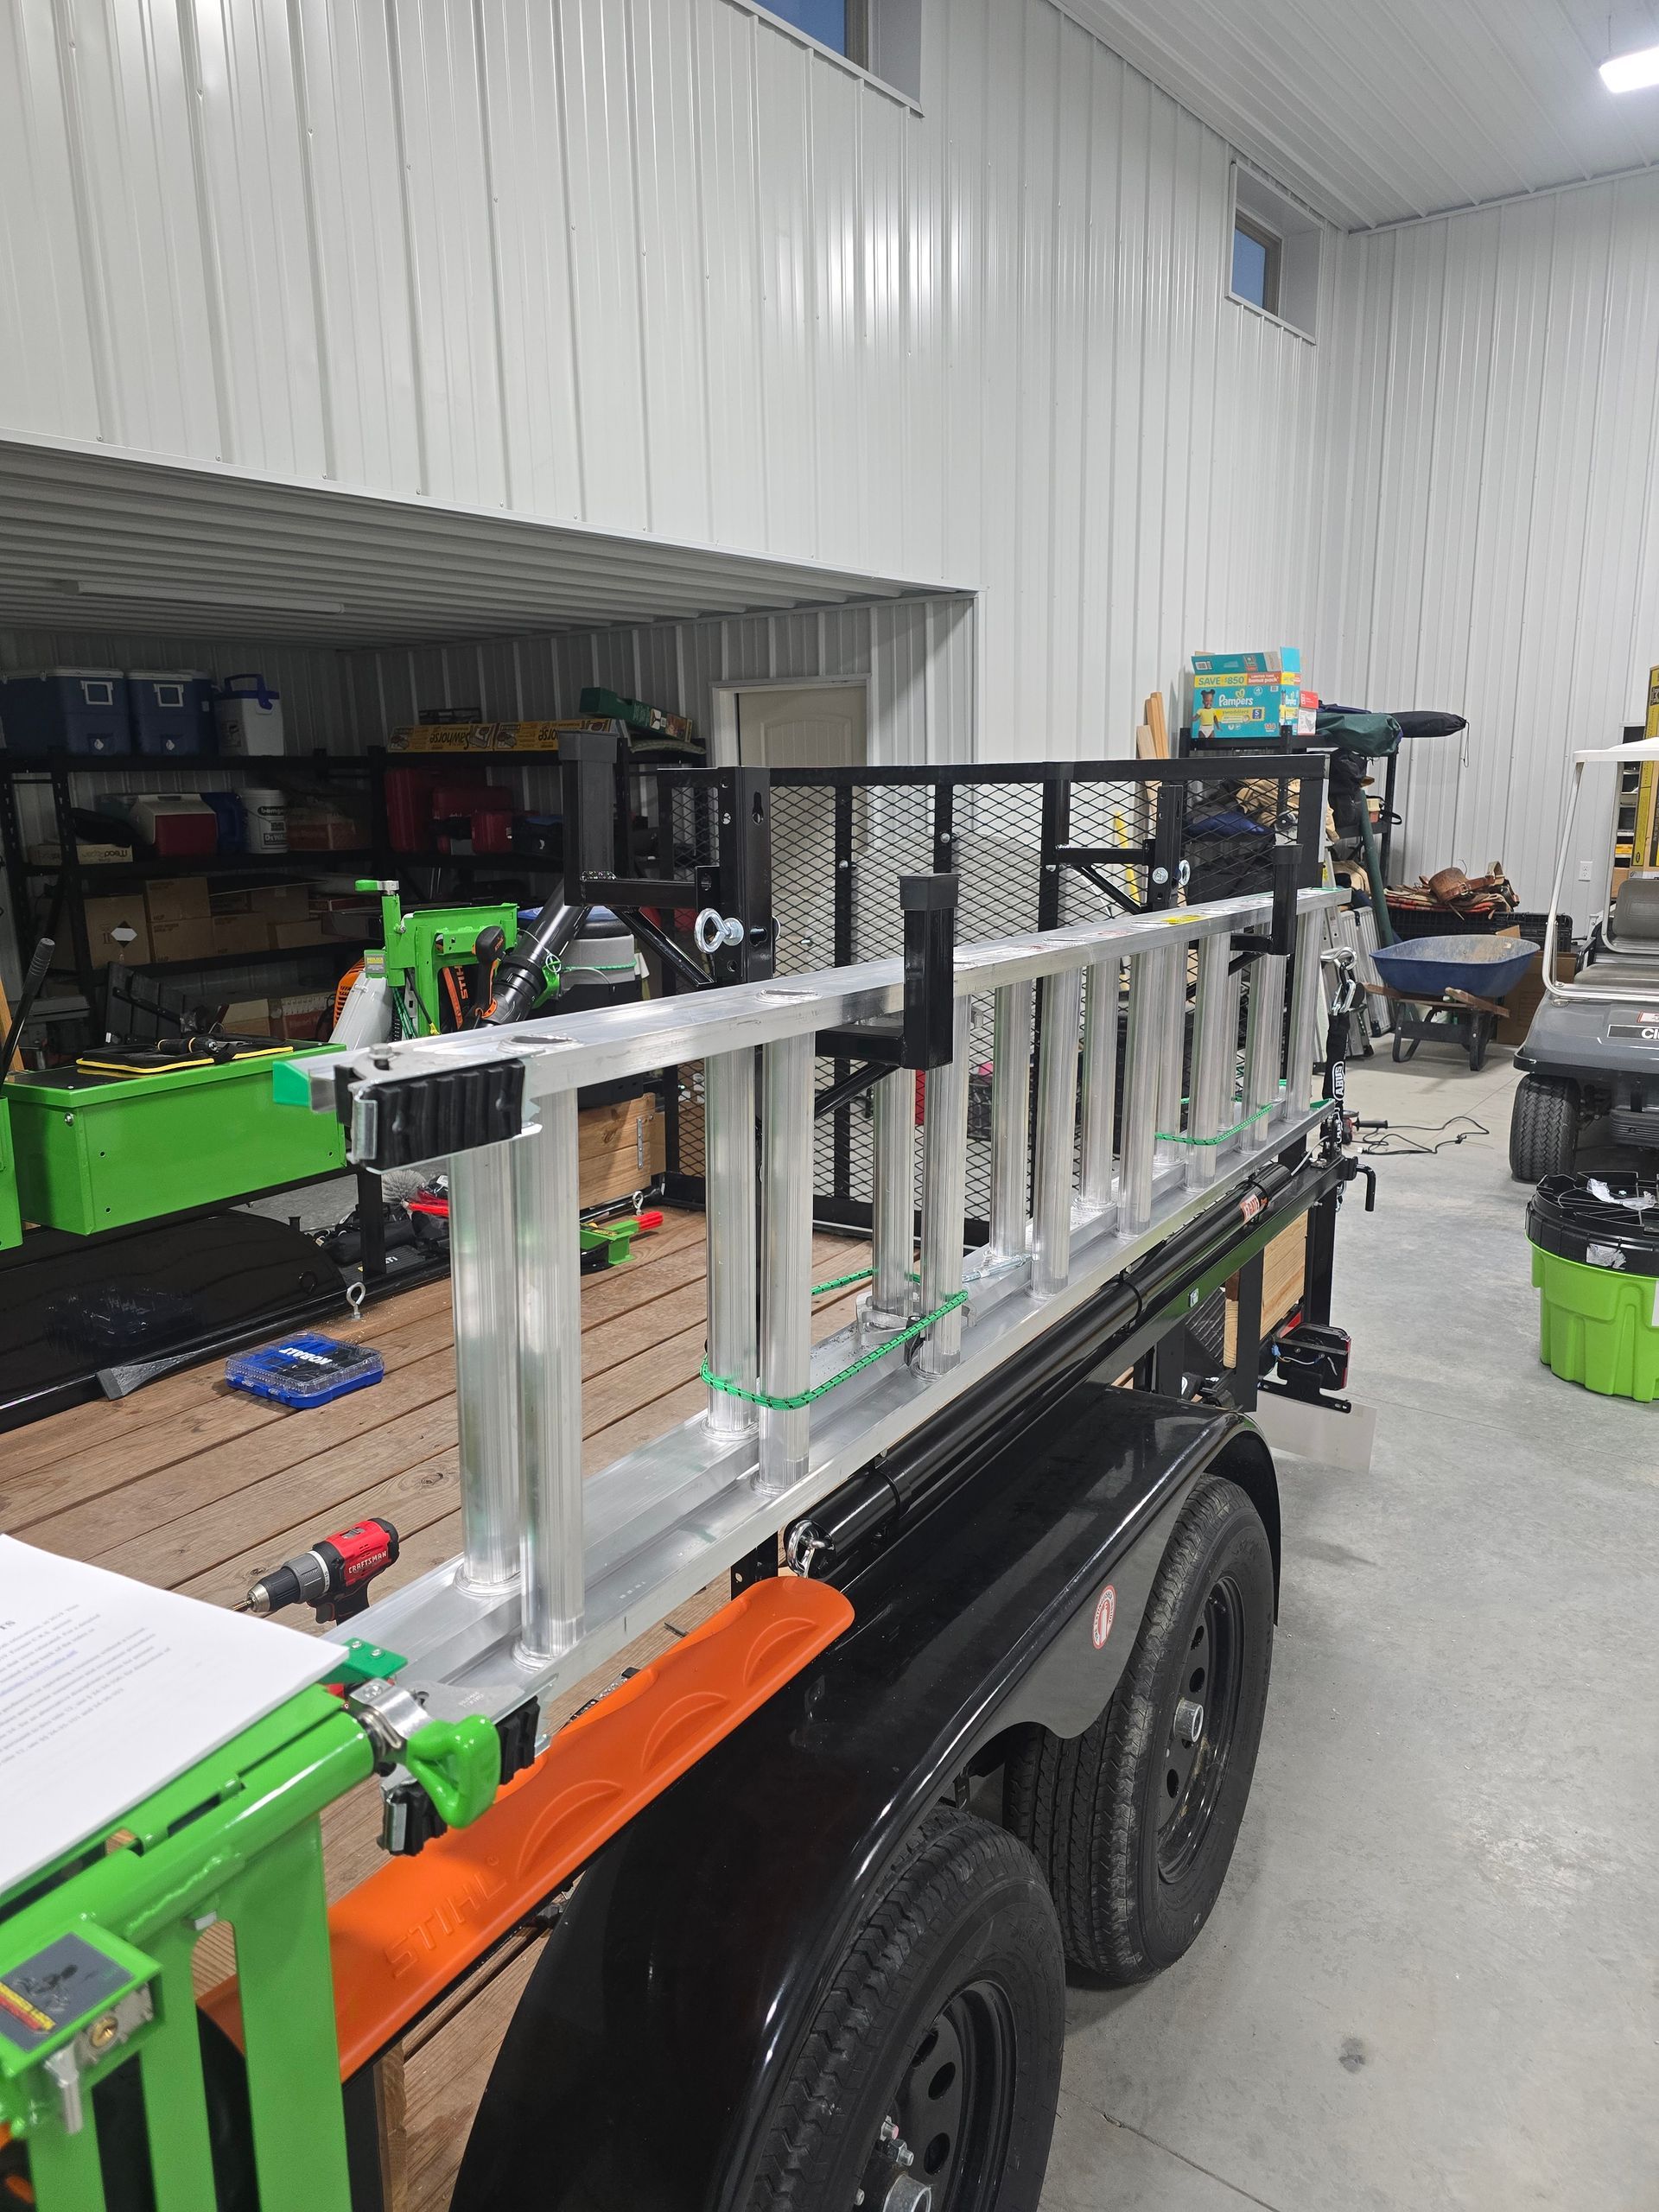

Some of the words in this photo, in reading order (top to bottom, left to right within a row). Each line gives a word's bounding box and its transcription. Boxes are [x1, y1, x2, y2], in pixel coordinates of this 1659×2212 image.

[1198, 677, 1221, 686] SAVE
[1218, 694, 1254, 708] Pampers
[429, 731, 471, 750] Sawhorse
[454, 964, 469, 1001] STIH
[1641, 1027, 1659, 1039] Cl
[1334, 1065, 1344, 1096] ABUS
[278, 1346, 334, 1365] KOBALT
[347, 1550, 388, 1574] CRAFTSMAN
[385, 1870, 508, 1980] STIHL
